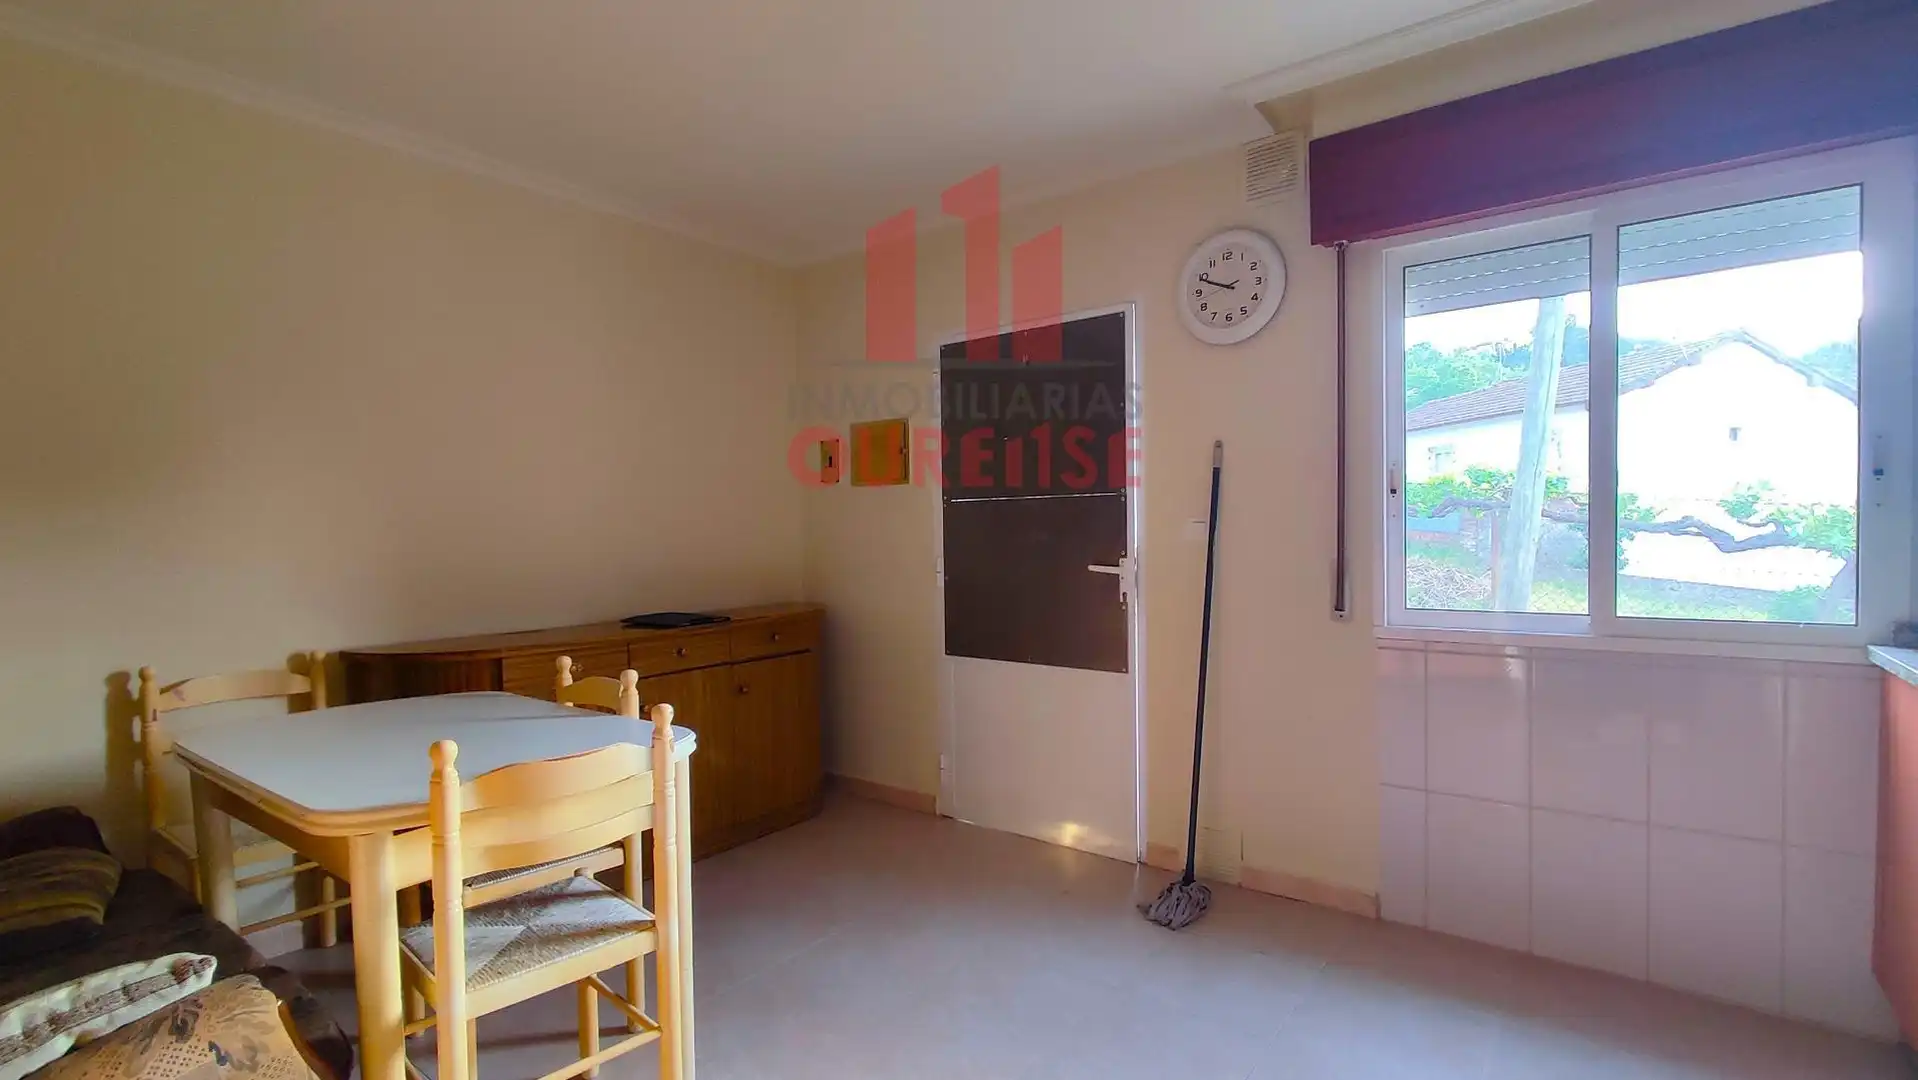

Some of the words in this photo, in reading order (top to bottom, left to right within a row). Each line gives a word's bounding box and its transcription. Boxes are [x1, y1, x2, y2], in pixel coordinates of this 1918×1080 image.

[1222, 251, 1233, 261] 12
[1209, 260, 1215, 268] 11
[1250, 262, 1258, 271] 2
[1199, 273, 1209, 281] 10
[1255, 277, 1262, 285] 3
[1196, 289, 1203, 297] 9
[1251, 293, 1259, 301] 4
[1200, 302, 1207, 311] 8
[1240, 306, 1247, 315] 5
[1211, 312, 1218, 321] 7
[1225, 313, 1233, 322] 6
